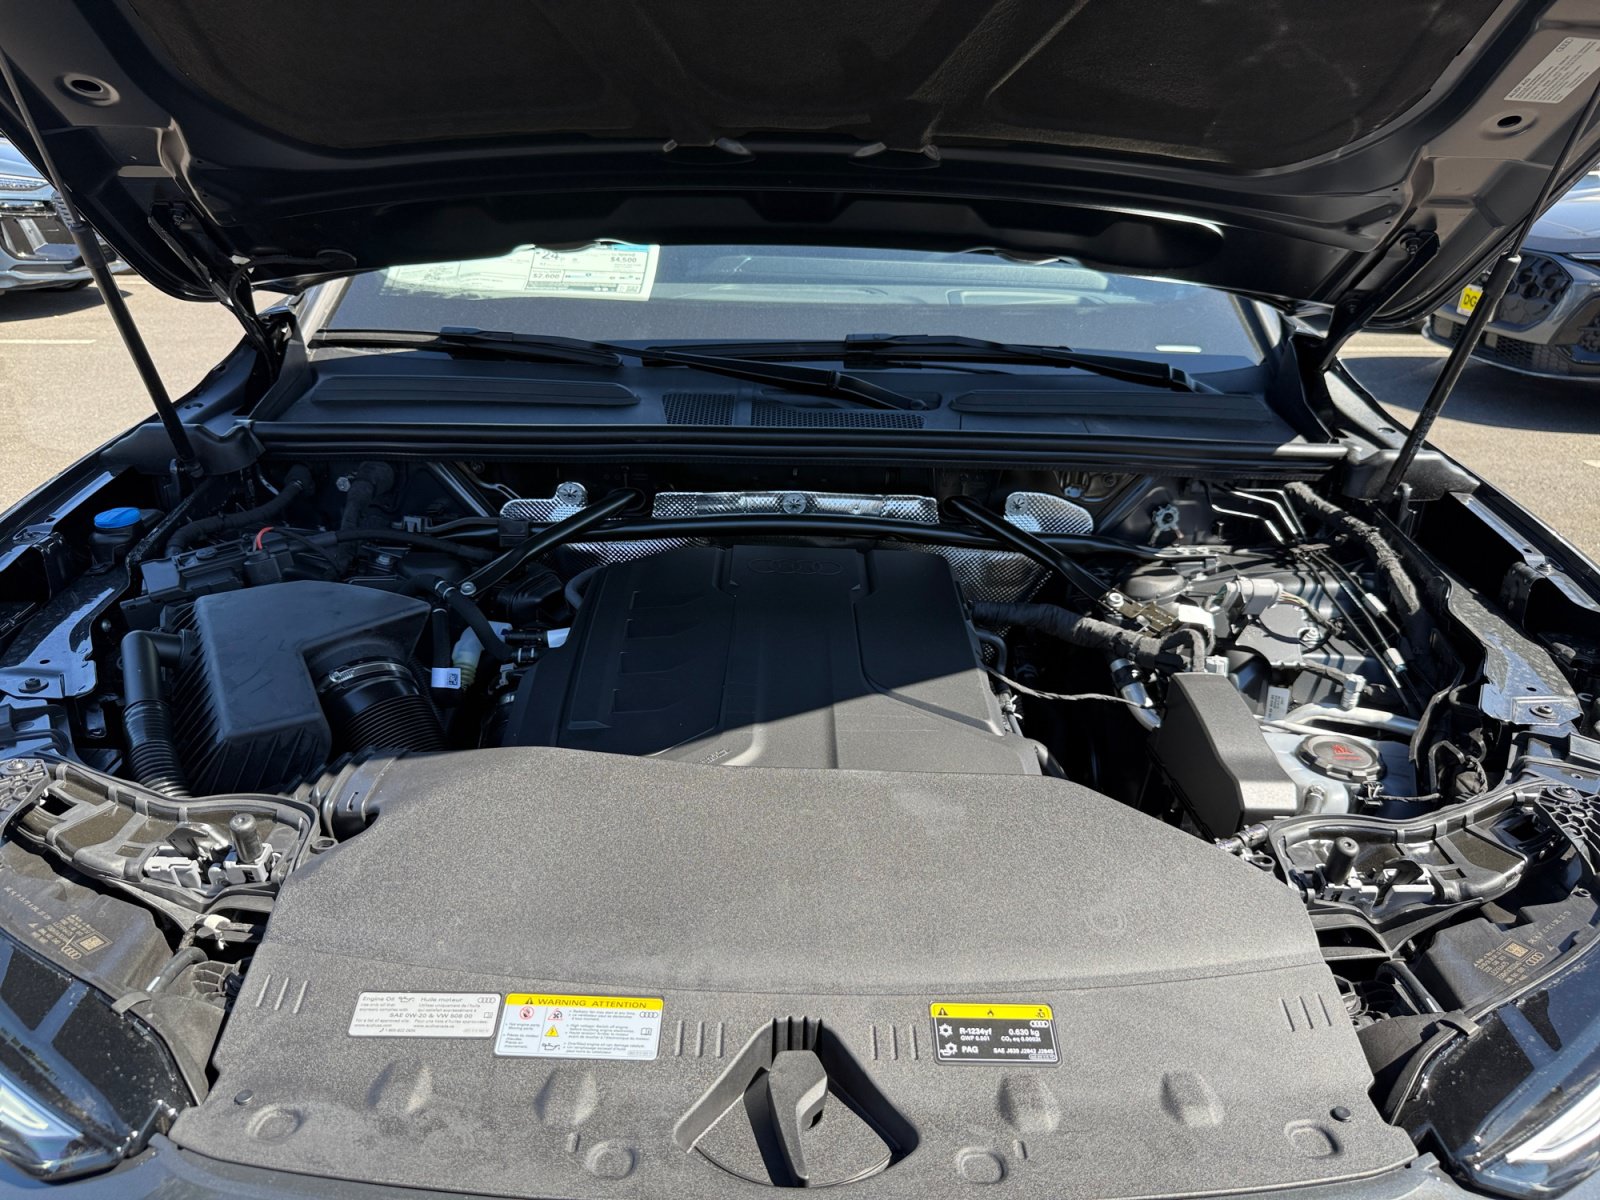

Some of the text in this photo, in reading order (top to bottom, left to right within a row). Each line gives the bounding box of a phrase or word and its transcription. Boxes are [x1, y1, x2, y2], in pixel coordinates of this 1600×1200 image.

[537, 998, 648, 1009] WARNING ATTENTION
[959, 1027, 1041, 1037] R-1234yf 0.630 kg
[961, 1045, 979, 1054] PAG
